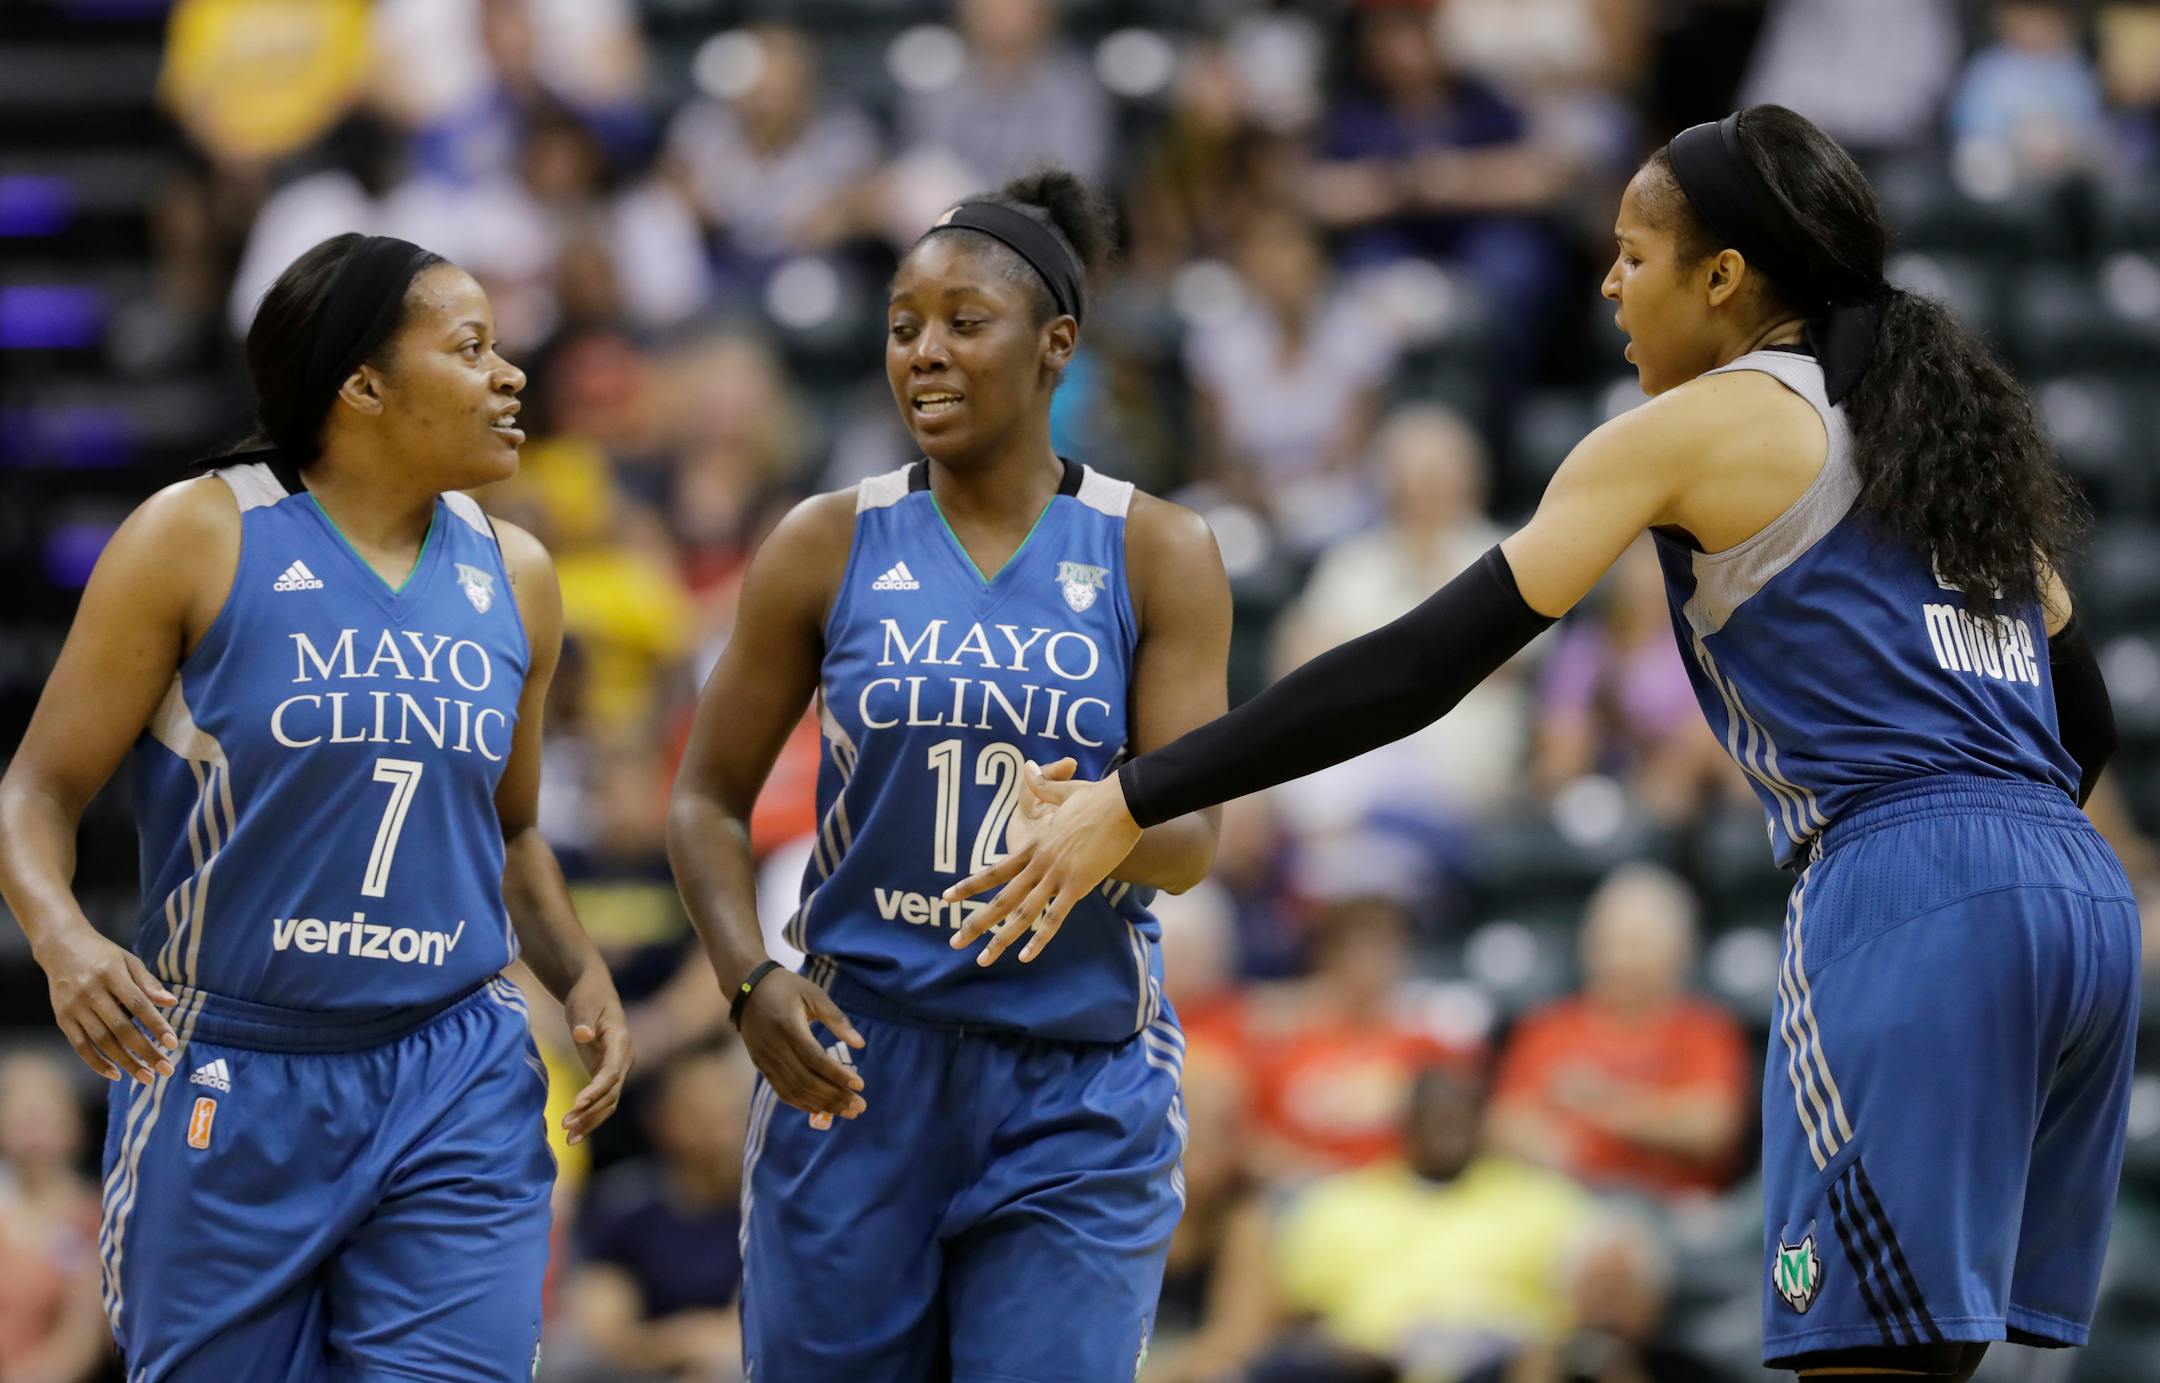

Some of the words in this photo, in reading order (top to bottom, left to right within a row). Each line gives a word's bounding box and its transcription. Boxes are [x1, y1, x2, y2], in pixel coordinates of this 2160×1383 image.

[273, 577, 324, 592] adidas
[872, 578, 920, 590] adidas
[289, 629, 491, 691] MAYO
[877, 619, 1099, 681] MAYO
[271, 691, 505, 761] CLINIC
[859, 676, 1111, 747] CLINIC
[361, 758, 423, 897] 7
[928, 739, 1026, 874] 12
[273, 912, 444, 966] verizon
[874, 888, 1055, 934] veri
